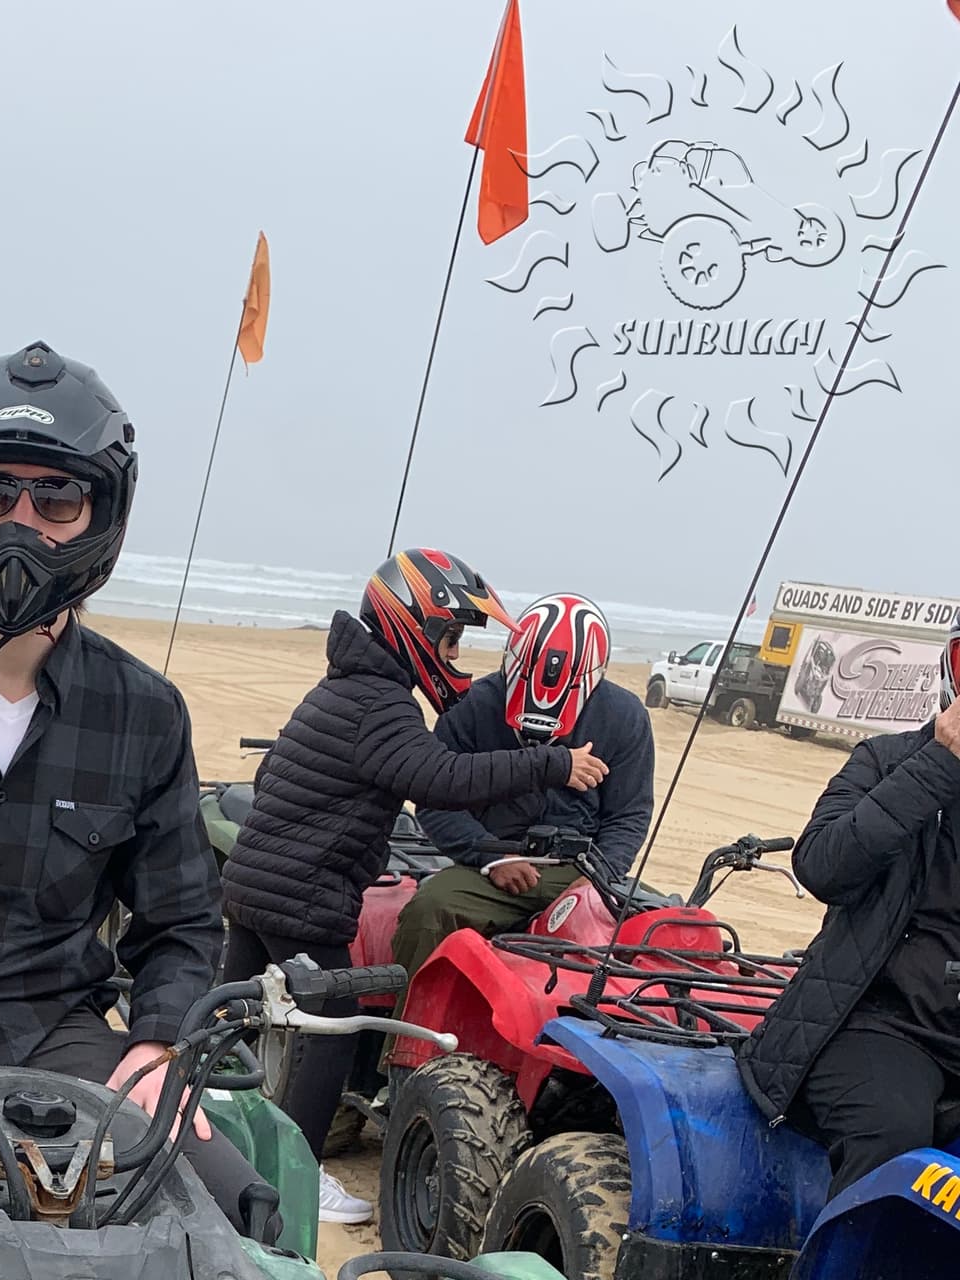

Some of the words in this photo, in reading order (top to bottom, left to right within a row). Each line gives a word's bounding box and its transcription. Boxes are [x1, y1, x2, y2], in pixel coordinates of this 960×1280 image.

[782, 588, 829, 612] QUADS
[829, 593, 863, 615] AND
[864, 597, 899, 619] SIDE
[901, 600, 926, 621] BY
[911, 1162, 960, 1221] KA
